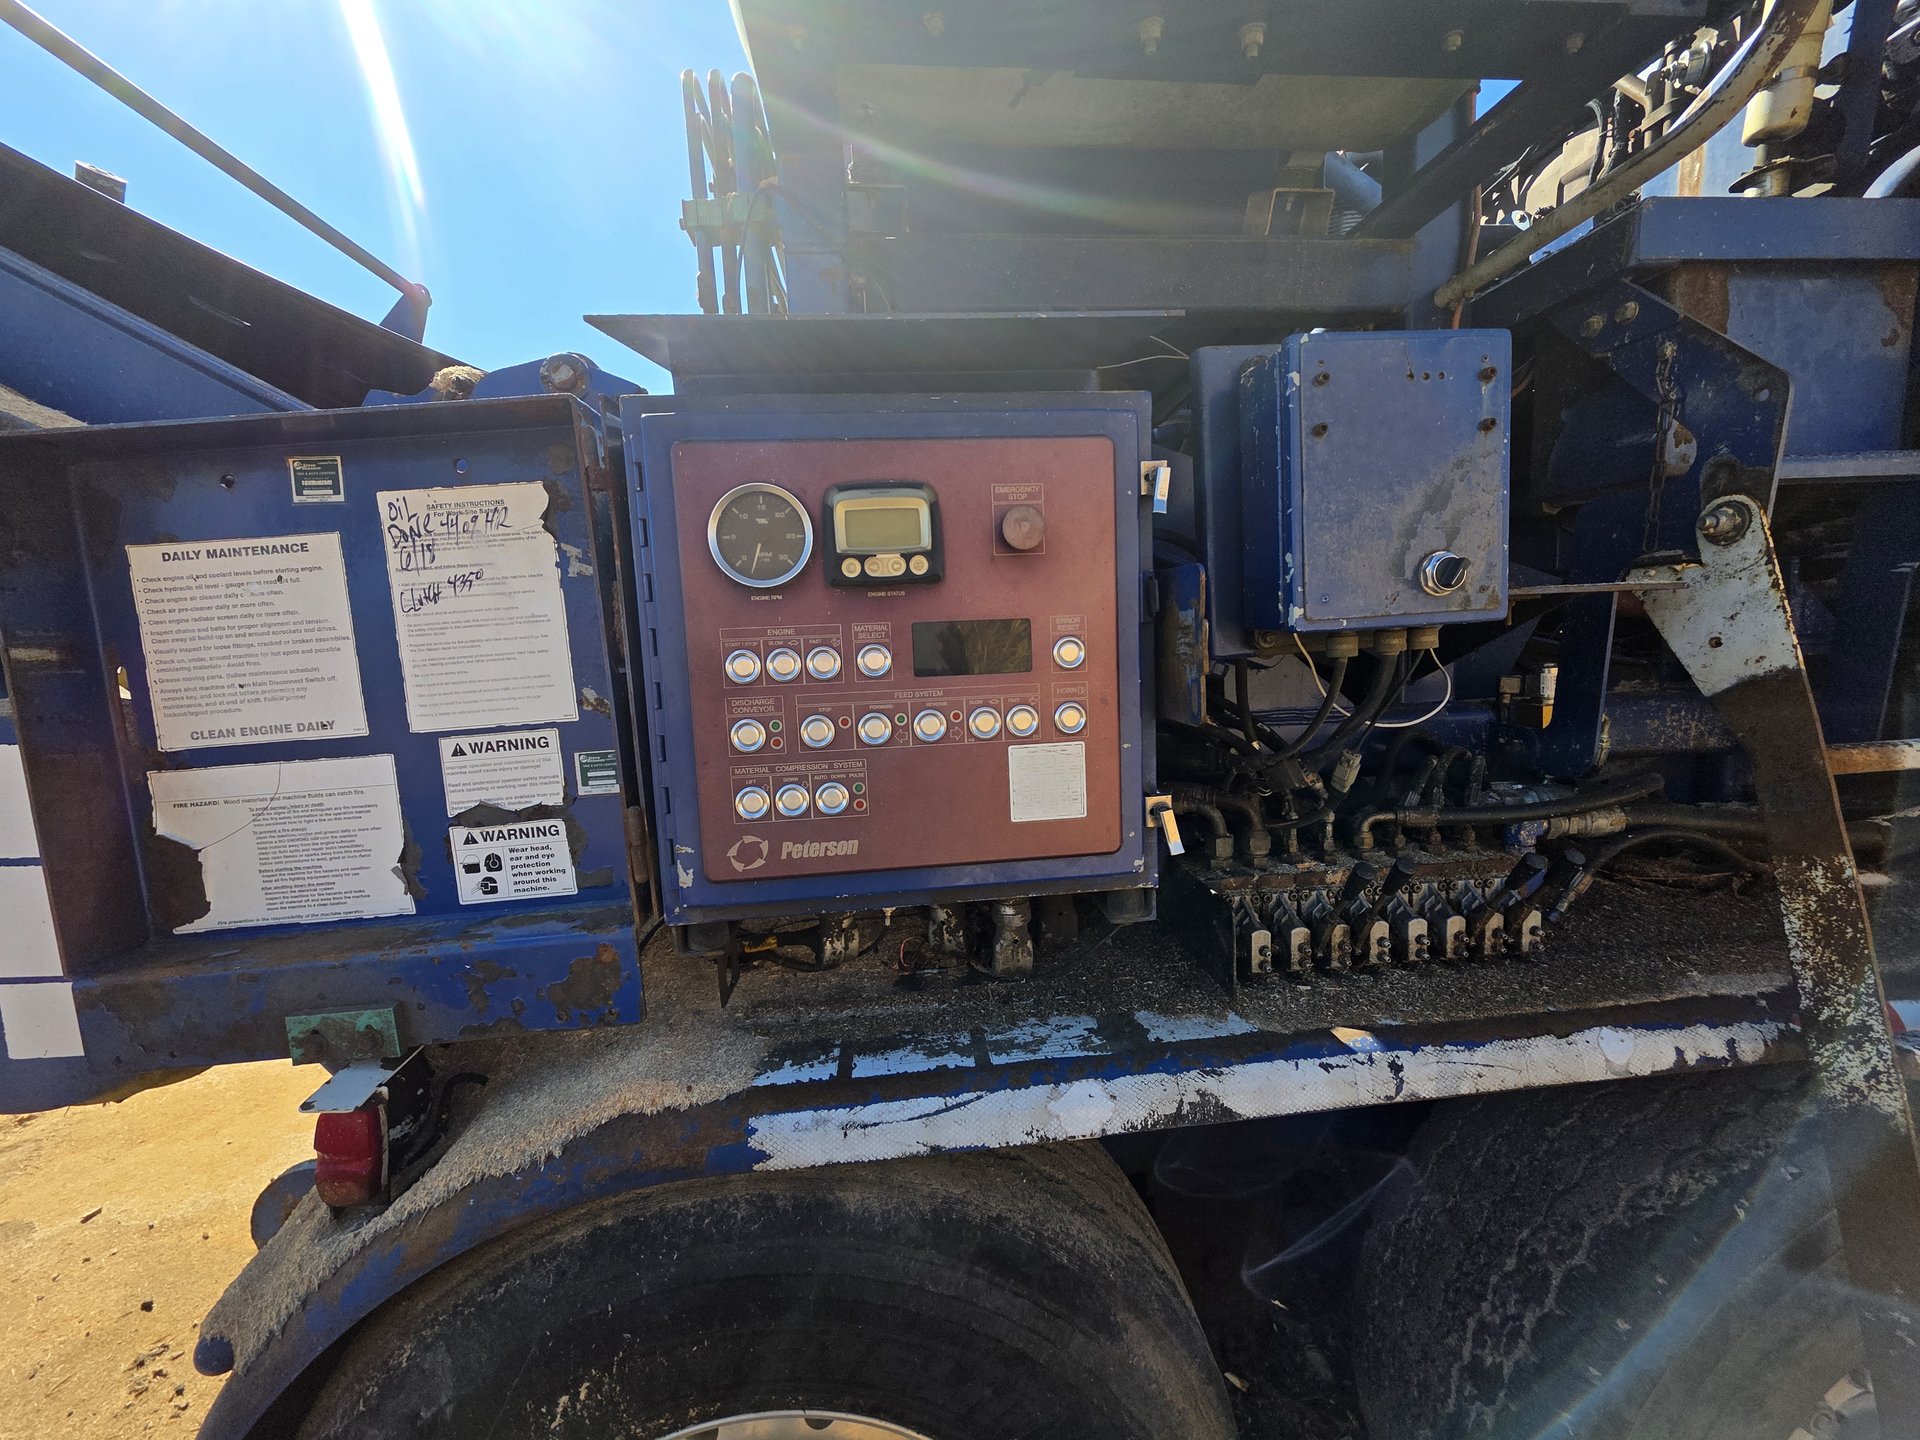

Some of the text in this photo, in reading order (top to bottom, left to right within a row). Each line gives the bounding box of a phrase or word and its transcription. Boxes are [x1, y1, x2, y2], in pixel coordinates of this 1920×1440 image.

[426, 499, 505, 510] SAFETY INSTRUCTIONS
[162, 542, 310, 562] DAILY MAINTENANCE
[275, 567, 299, 575] starting
[164, 585, 194, 594] hydraulic
[178, 605, 214, 614] pre-cleaner
[260, 621, 291, 629] alignment
[732, 698, 775, 707] DISCHARGE
[190, 720, 336, 741] CLEAN ENGINE DAILY
[468, 736, 550, 755] WARNING
[776, 763, 828, 772] COMPRESSION
[480, 825, 560, 842] WARNING
[781, 840, 859, 860] Peterson
[511, 861, 551, 870] protection
[512, 868, 566, 877] when working
[514, 885, 550, 893] machine.
